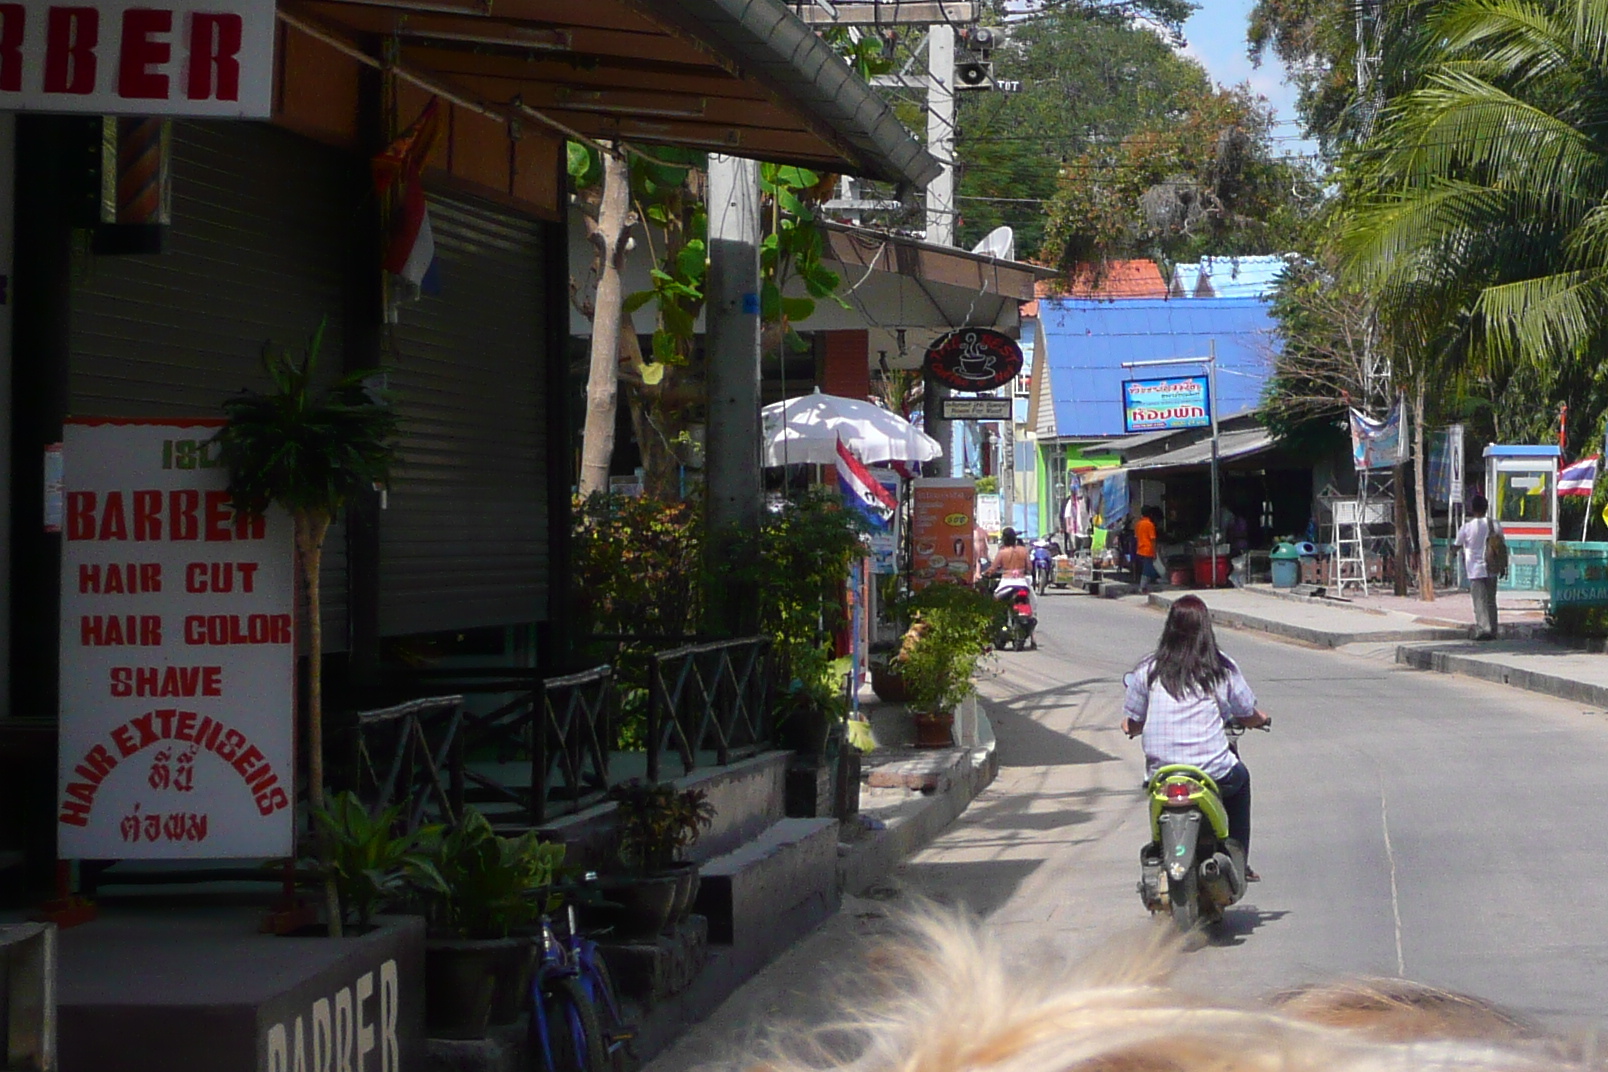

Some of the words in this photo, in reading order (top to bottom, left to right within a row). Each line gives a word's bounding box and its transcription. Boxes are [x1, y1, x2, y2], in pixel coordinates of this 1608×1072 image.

[997, 80, 1019, 91] TOT
[79, 563, 162, 593] HAIR
[185, 562, 258, 593] CUT
[81, 615, 162, 646] HAIR
[184, 614, 291, 645] COLOR
[110, 666, 222, 697] SHAVE
[59, 744, 118, 827] HAIR
[110, 708, 288, 817] EXTENSENS
